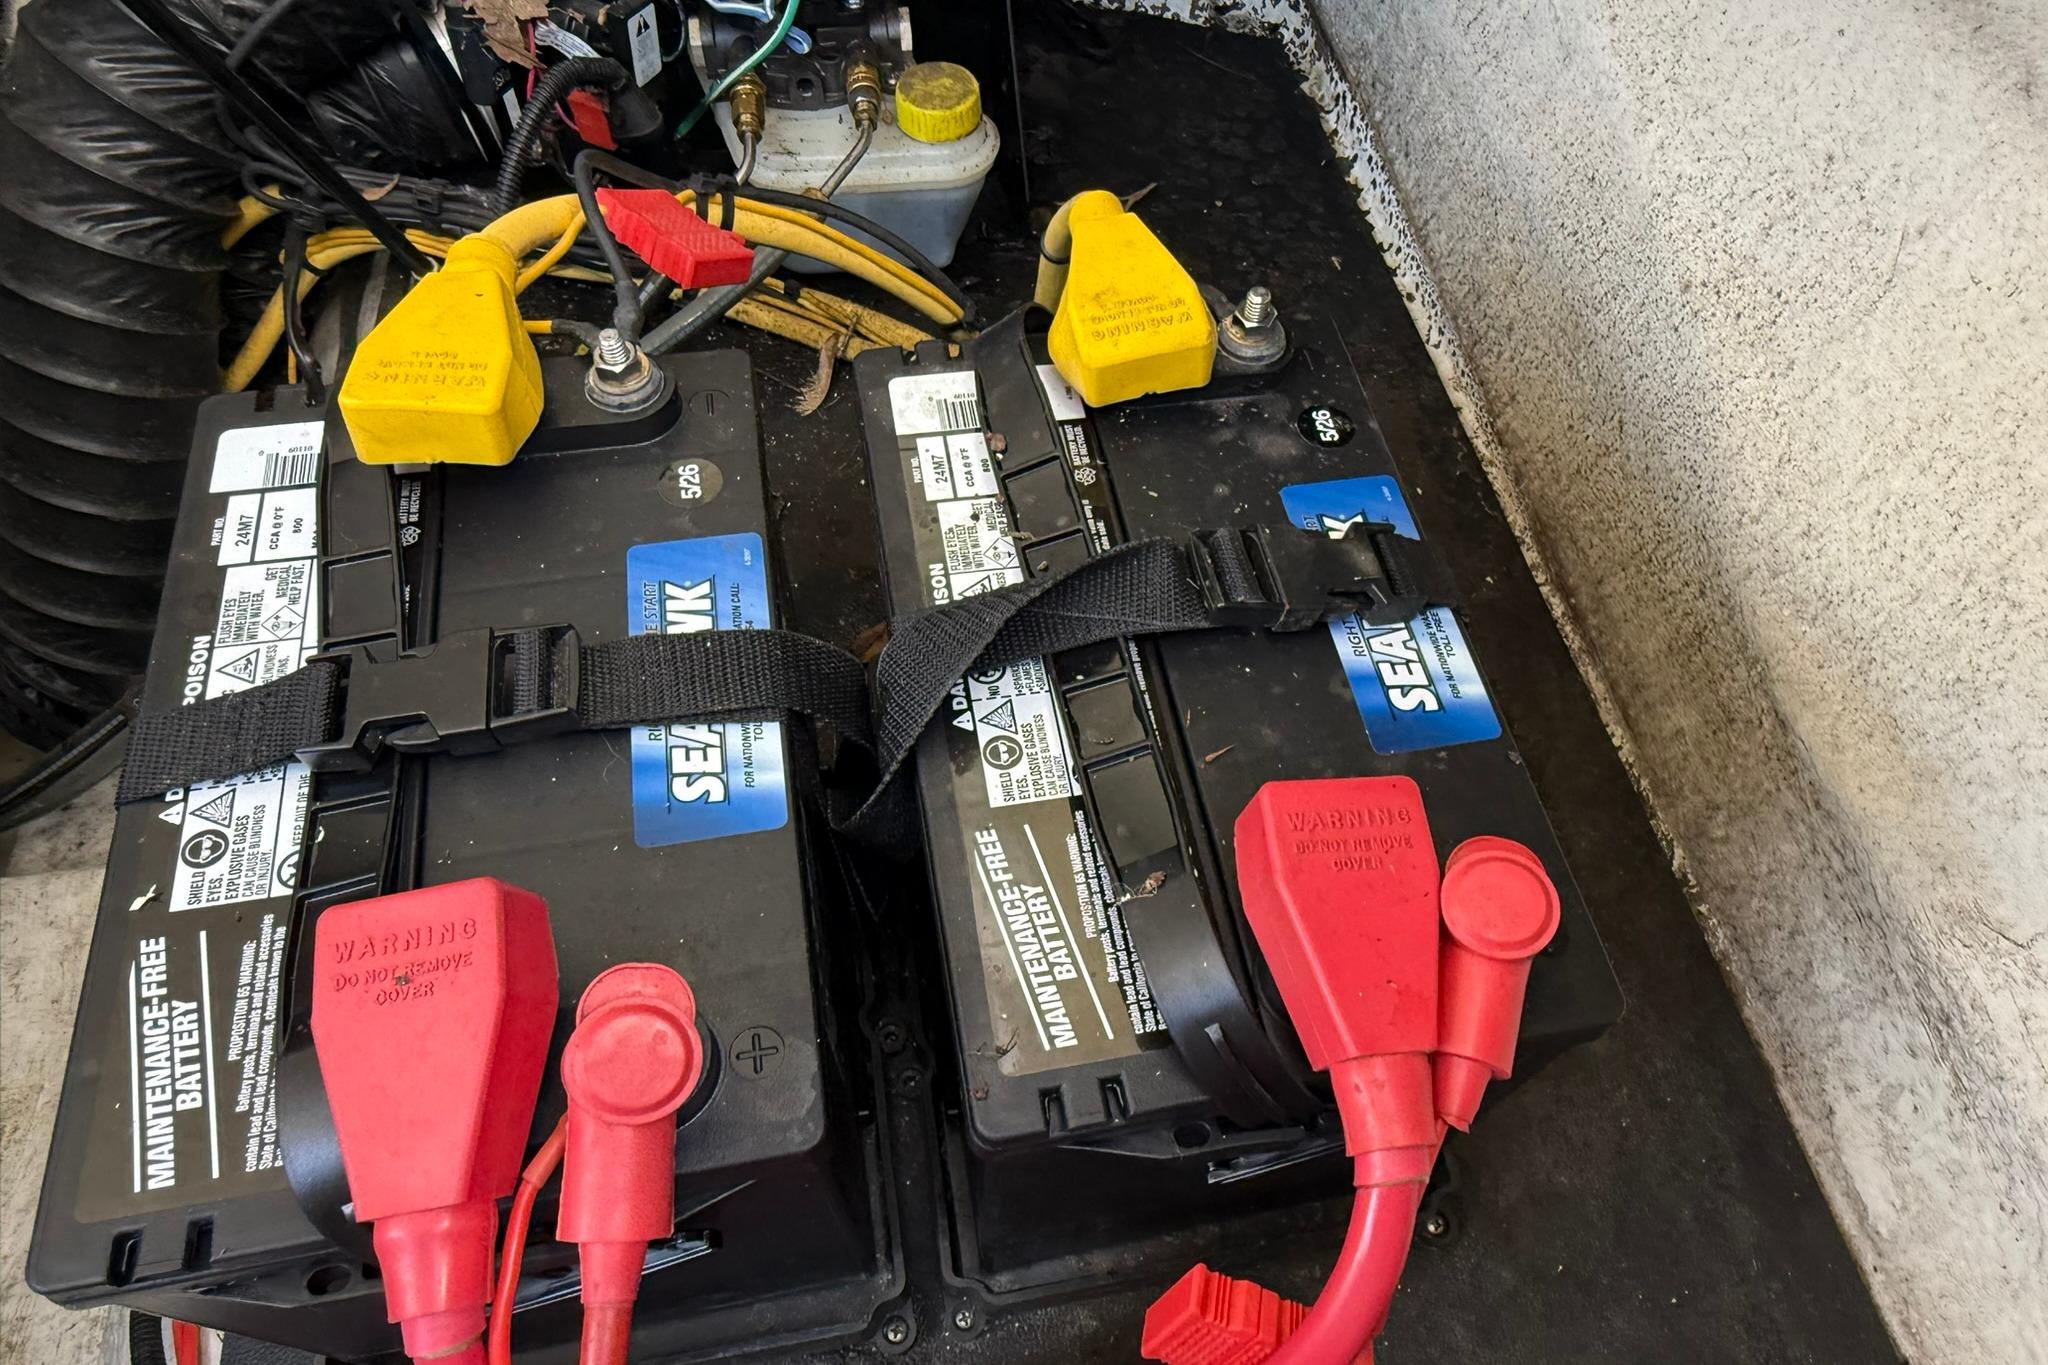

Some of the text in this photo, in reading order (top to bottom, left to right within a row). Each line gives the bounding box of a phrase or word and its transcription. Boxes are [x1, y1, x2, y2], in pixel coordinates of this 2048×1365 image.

[1312, 409, 1340, 442] 5/26
[913, 466, 923, 484] PART
[931, 455, 949, 484] 24M7
[963, 469, 975, 488] CCA
[980, 458, 991, 473] 800
[680, 463, 702, 500] 5/26
[234, 514, 254, 547] 24M7
[292, 518, 303, 534] 800
[982, 500, 998, 531] MEDICAL
[269, 530, 281, 550] CCA
[954, 524, 972, 570] IMMEDIATELY
[967, 524, 984, 568] WITH WATER.
[265, 566, 279, 580] GET
[947, 549, 961, 571] FLUSH
[275, 564, 292, 598] MEDICAL
[288, 564, 305, 606] HELP FAST.
[730, 581, 740, 603] CALL:
[929, 563, 950, 605] ISON
[245, 589, 265, 641] WITH WATER.
[642, 581, 658, 620] START
[218, 598, 237, 644] FLUSH EYES
[232, 591, 251, 643] IMMEDIATELY
[1430, 610, 1456, 658] TOLL FREE
[1426, 631, 1456, 682] NATIONWIDE
[988, 686, 1000, 698] NO
[1448, 683, 1462, 699] FOR
[1020, 722, 1046, 798] EXPLOSIVE GASES
[1033, 713, 1058, 796] CAN CAUSE BLINDNESS
[744, 770, 755, 788] FOR
[999, 772, 1016, 802] SHIELD
[1058, 783, 1070, 794] OR
[1074, 810, 1091, 852] accessories
[1286, 807, 1412, 832] WARNING
[224, 814, 250, 900] EXPLOSIVE GASES
[242, 804, 266, 898] CAN CAUSE BLINDNESS
[1066, 833, 1084, 873] WARNING:
[1294, 834, 1414, 854] DO NOT REMOVE
[255, 849, 272, 896] OR INJURY.
[1075, 873, 1086, 884] 65
[1082, 850, 1098, 878] related
[1331, 855, 1384, 872] COVER
[187, 871, 206, 906] SHIELD
[1089, 878, 1102, 892] and
[1078, 884, 1097, 939] PROPOSITION
[1092, 892, 1109, 929] terminals
[272, 940, 285, 950] to
[273, 926, 286, 940] the
[335, 918, 476, 964] WARNING
[976, 828, 1079, 1049] MAINTENANCE-FREE
[1020, 883, 1078, 981] BATTERY
[268, 950, 283, 978] known
[336, 952, 473, 992] DO NOT REMOVE
[1105, 954, 1119, 983] Battery
[1116, 951, 1129, 969] lead
[1120, 968, 1134, 985] and
[1132, 962, 1150, 1000] California
[228, 940, 257, 1062] PROPOSITION 65 WARNING:
[263, 976, 279, 1020] chemicals
[376, 981, 435, 1006] COVER
[1122, 985, 1137, 1004] lead
[1140, 1000, 1152, 1010] of
[235, 914, 274, 1112] Battery posts, terminals and related accessories
[1128, 1004, 1144, 1034] contain
[1144, 1010, 1157, 1032] State
[172, 1000, 203, 1110] BATTERY
[258, 1020, 276, 1074] compounds,
[140, 936, 175, 1190] MAINTENANCE-FREE
[253, 1075, 268, 1096] lead
[252, 1096, 266, 1115] and
[248, 1115, 263, 1137] lead
[262, 1132, 276, 1144] of
[245, 1136, 260, 1172] contain
[258, 1144, 274, 1170] State
